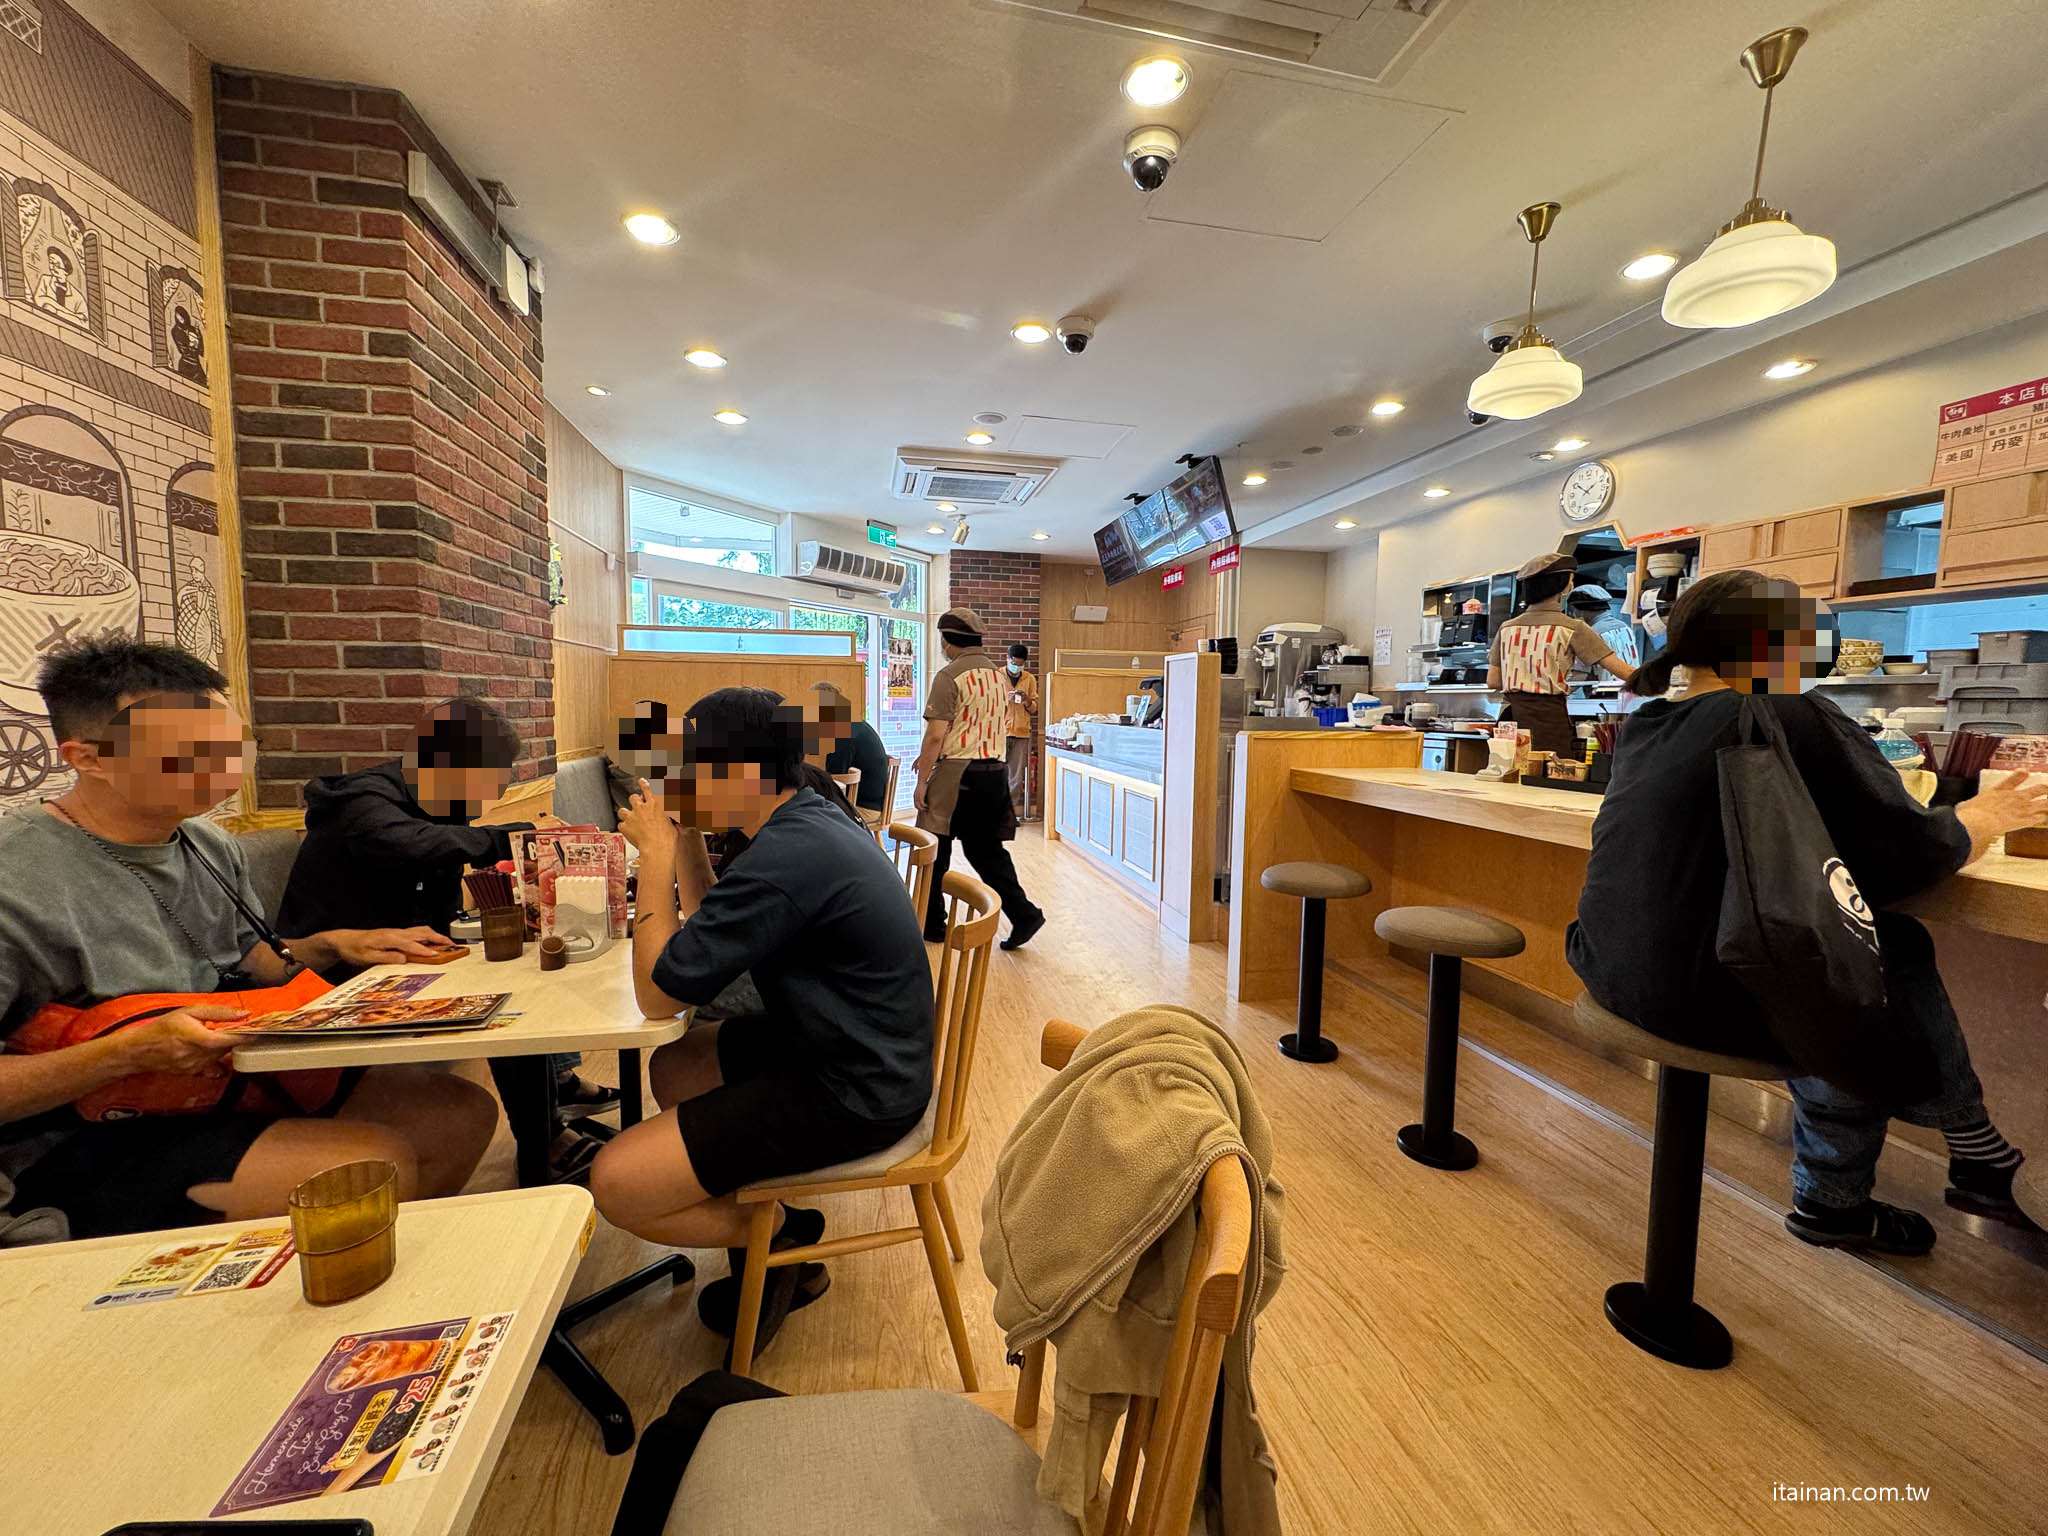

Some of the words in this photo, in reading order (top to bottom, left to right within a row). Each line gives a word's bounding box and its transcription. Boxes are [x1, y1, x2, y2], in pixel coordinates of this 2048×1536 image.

[1945, 448, 1974, 464] 美國
[1991, 435, 2024, 452] 丹麥
[333, 1391, 356, 1415] Tea
[395, 1375, 436, 1414] $25
[319, 1415, 349, 1441] Grey
[243, 1415, 305, 1495] Homemade
[286, 1431, 314, 1458] Ice
[297, 1439, 326, 1475] Earl
